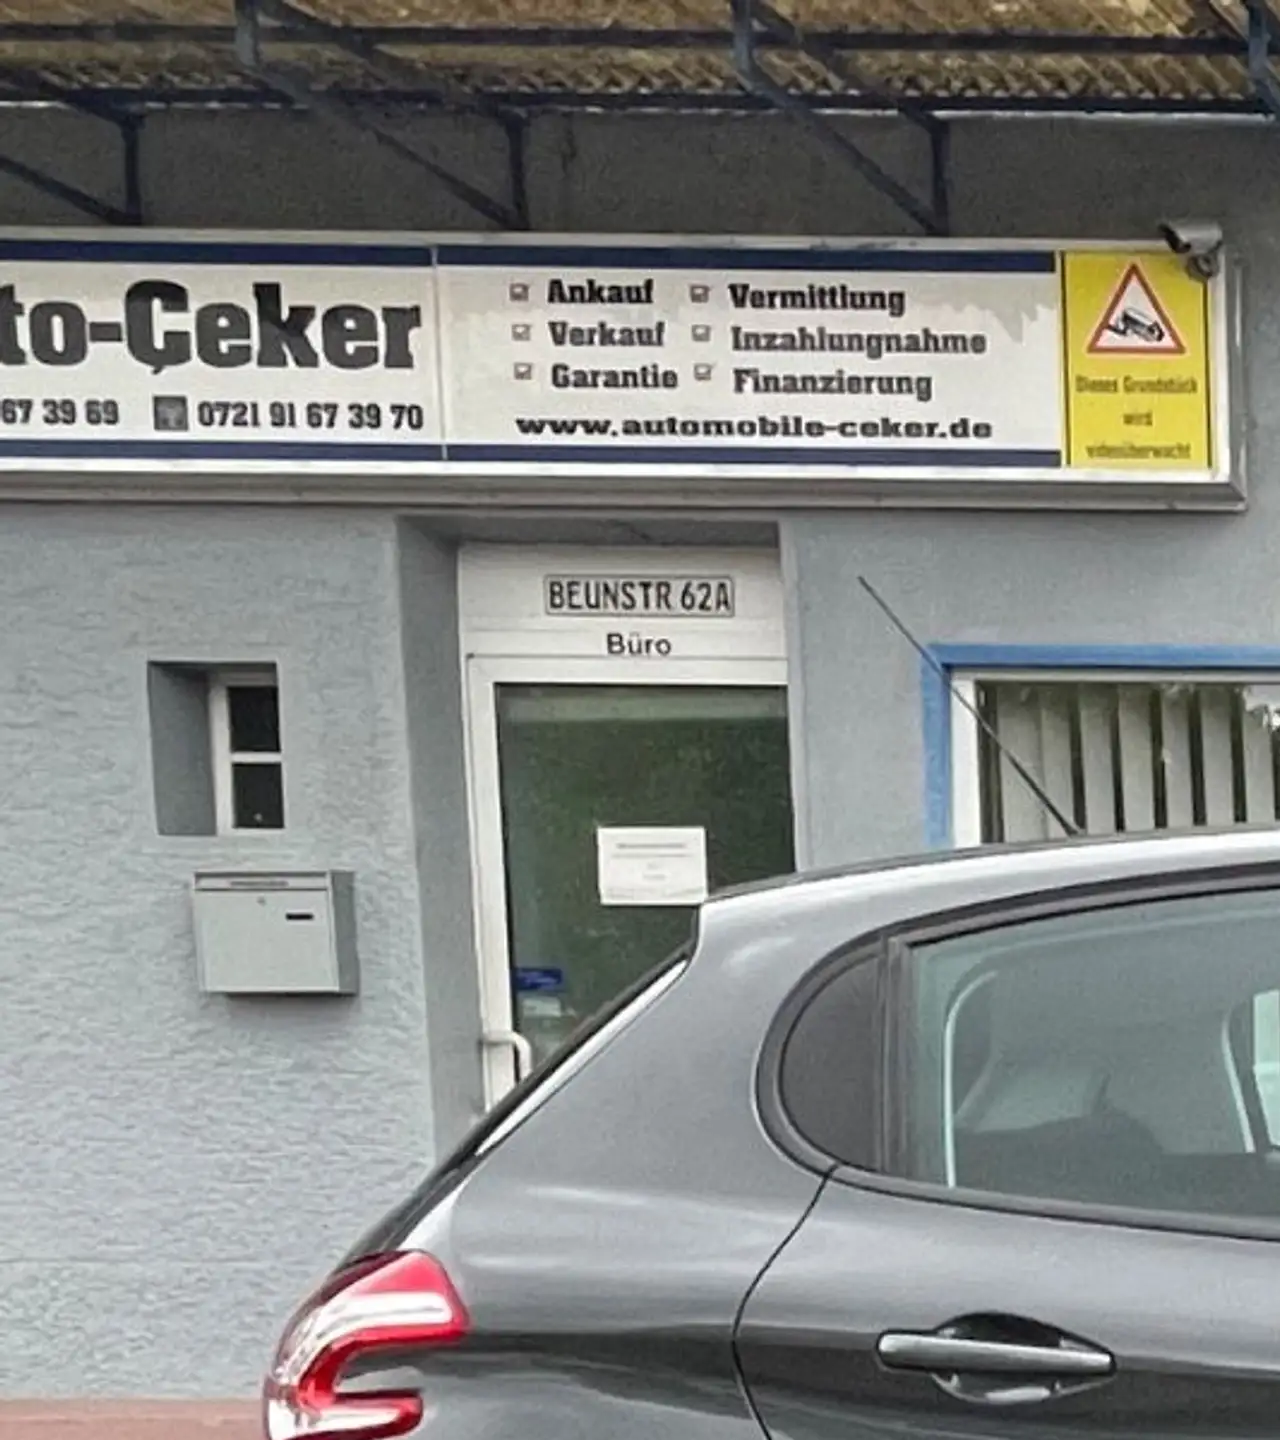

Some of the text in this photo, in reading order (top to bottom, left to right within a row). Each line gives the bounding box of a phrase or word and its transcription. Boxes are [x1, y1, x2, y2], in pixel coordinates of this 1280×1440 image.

[547, 279, 654, 305] Ankauf
[729, 285, 906, 316] Vermittlung
[549, 322, 666, 348] Verkauf
[731, 327, 986, 358] Inzahlungnahme
[551, 363, 679, 390] Garantie
[734, 371, 932, 402] Finanzierung
[1, 399, 120, 426] 67 39 69
[198, 401, 423, 430] 0721 91 67 39 70
[516, 415, 992, 440] www.automobile-ceker.de
[549, 581, 731, 612] BEUNSTR 62A
[607, 634, 671, 656] Büro
